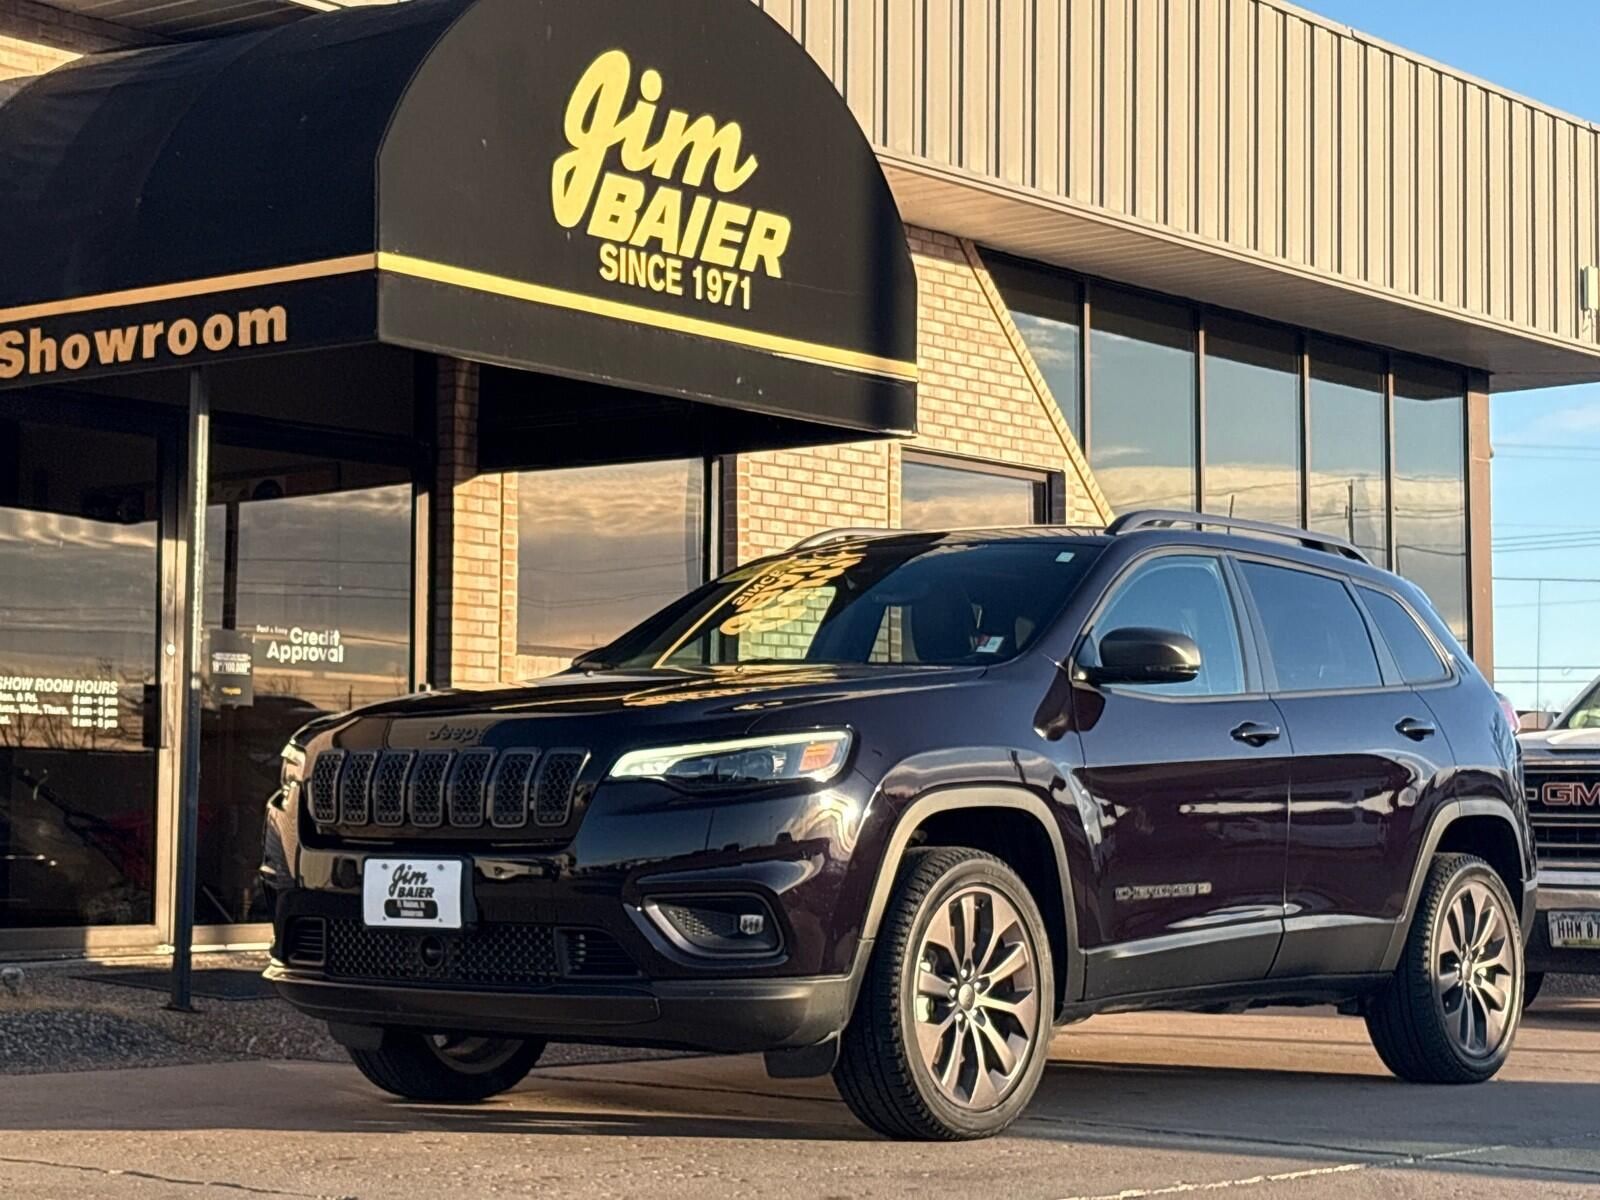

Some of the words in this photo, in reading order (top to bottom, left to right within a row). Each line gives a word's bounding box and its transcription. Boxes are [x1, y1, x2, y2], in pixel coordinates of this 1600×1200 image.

[552, 50, 759, 228] Jim
[587, 172, 791, 278] BAIER
[599, 243, 683, 296] SINCE
[692, 265, 750, 310] 1971
[0, 305, 287, 379] Showroom
[290, 627, 340, 646] Credit
[266, 640, 344, 664] Approval
[0, 676, 34, 691] SHOW
[34, 678, 73, 693] ROOM
[75, 679, 118, 695] HOURS
[0, 704, 19, 714] ues.,
[388, 863, 428, 897] Jim
[397, 886, 434, 898] BAIER
